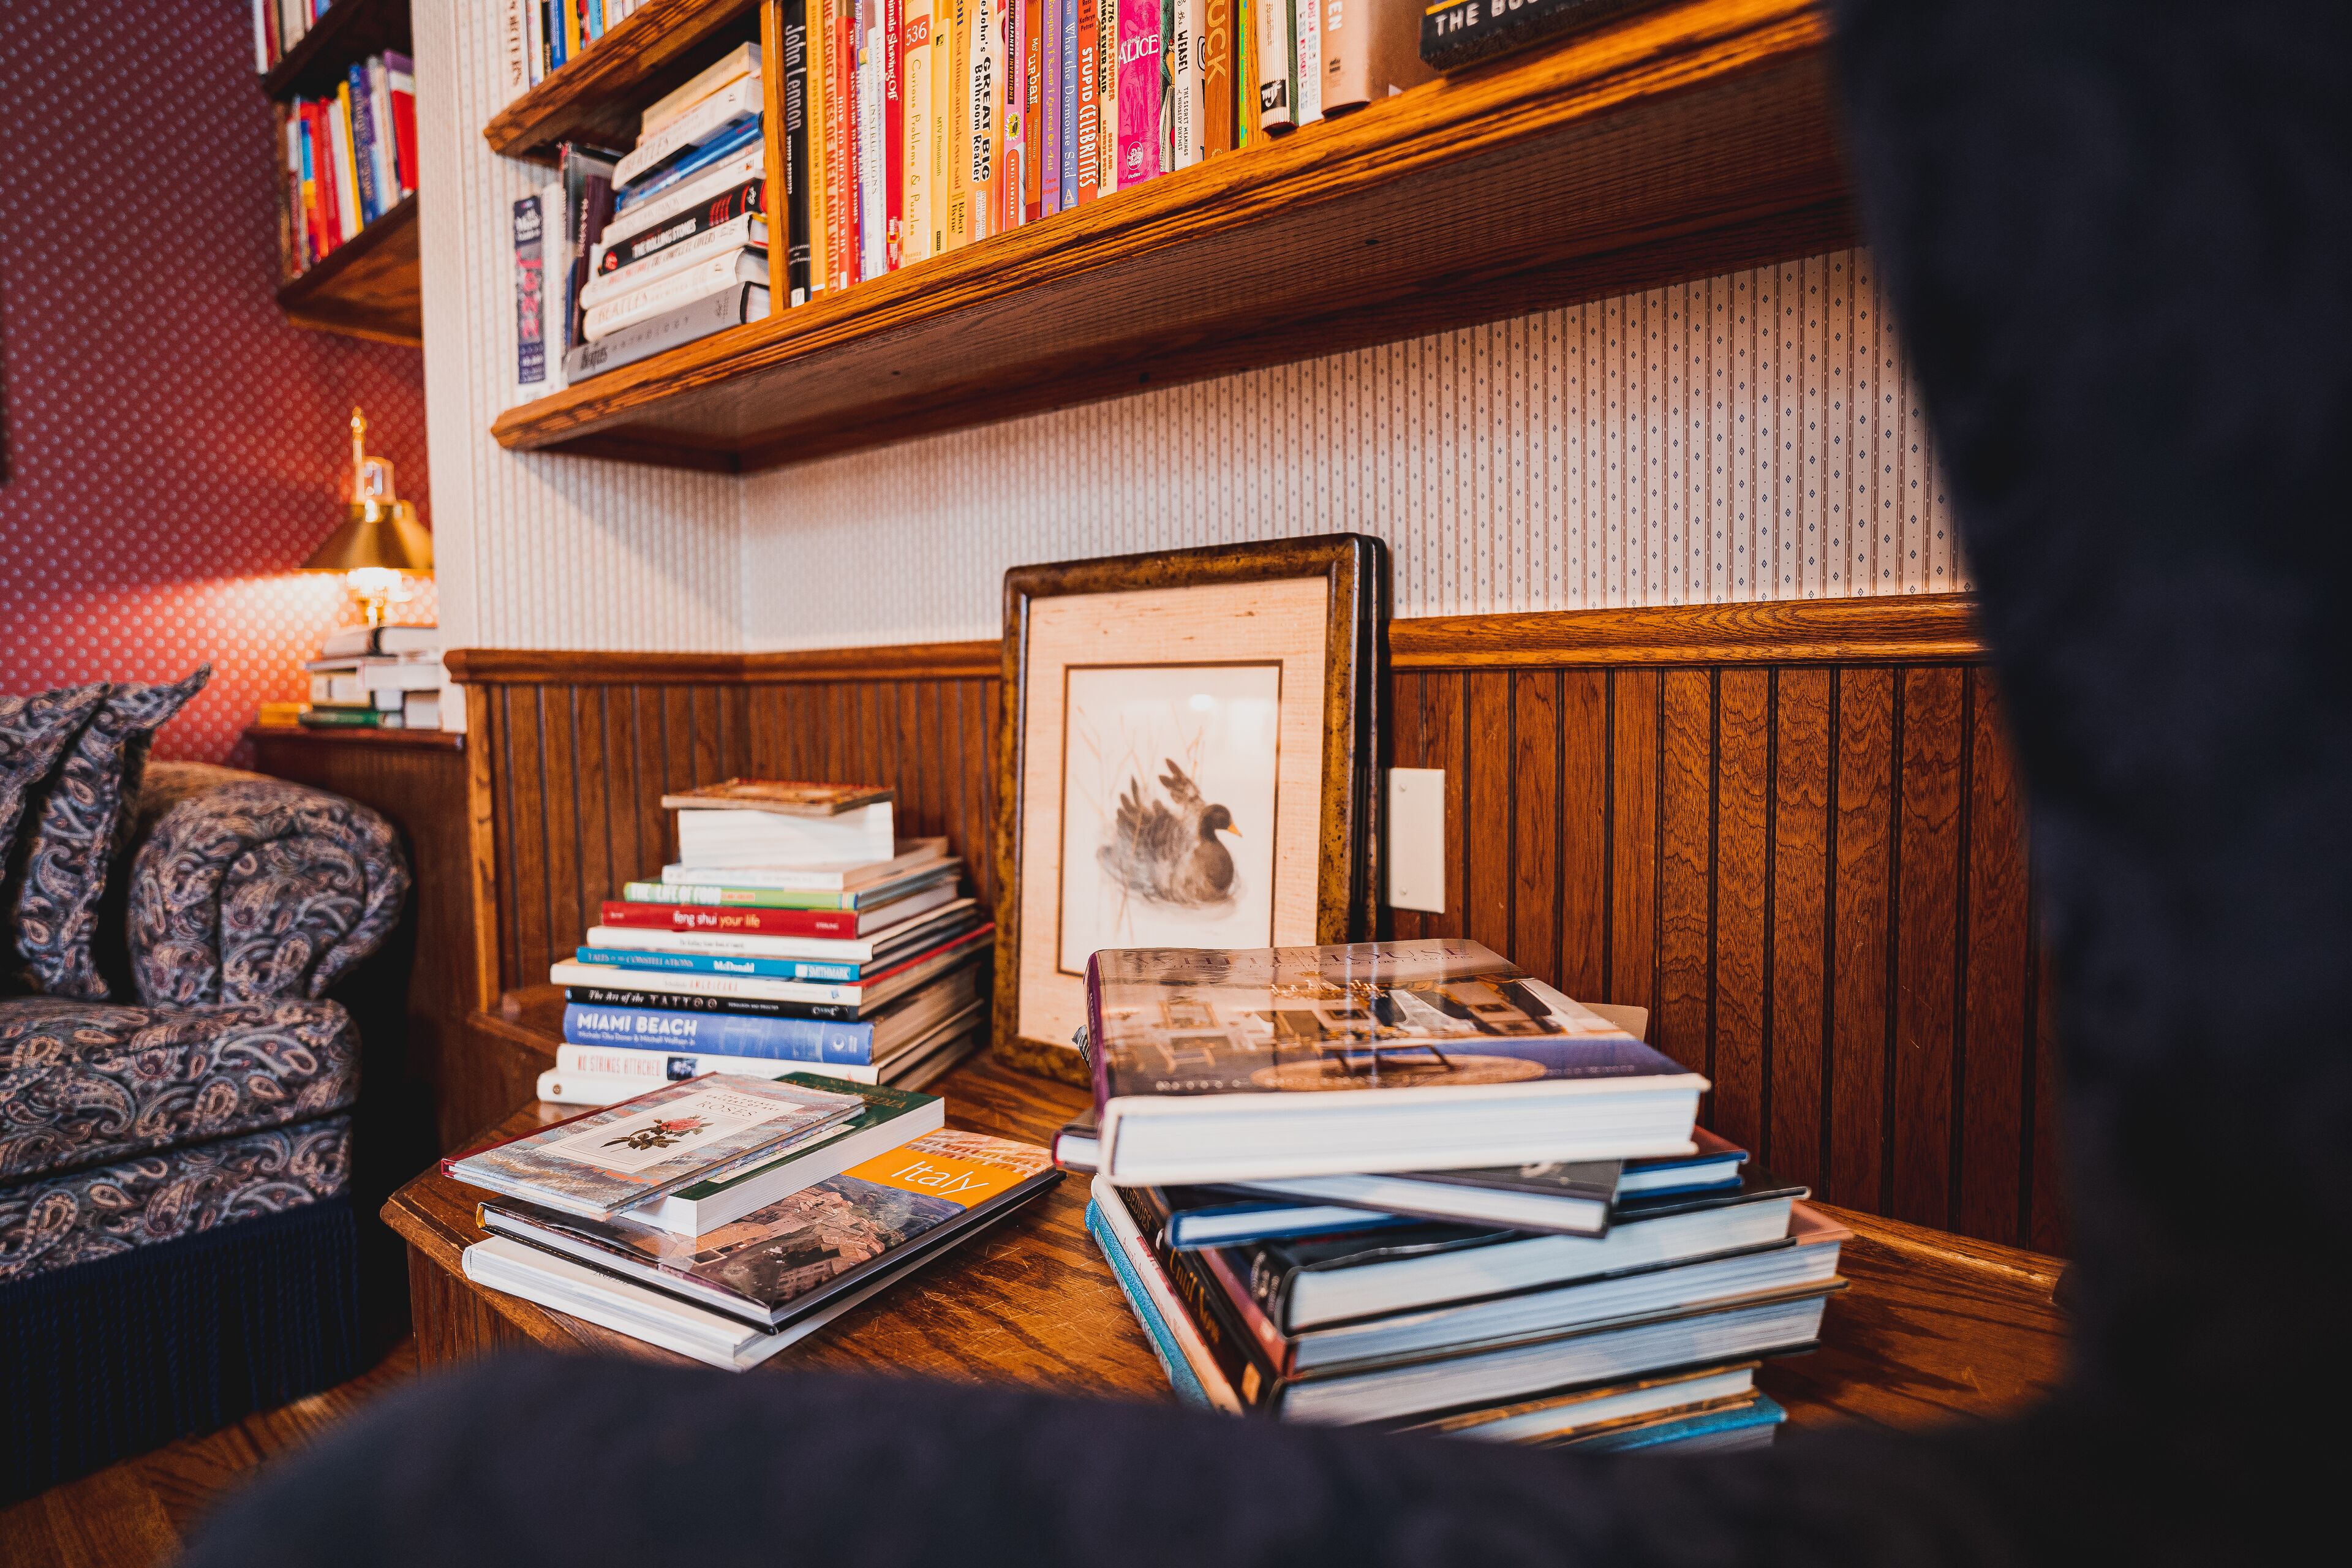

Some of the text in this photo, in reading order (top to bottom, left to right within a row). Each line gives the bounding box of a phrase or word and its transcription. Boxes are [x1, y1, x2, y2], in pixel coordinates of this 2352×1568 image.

[980, 9, 989, 53] John's
[1046, 0, 1056, 48] Everything
[1079, 13, 1096, 24] Kathryn
[1080, 22, 1094, 32] Petras
[1327, 0, 1344, 32] EN
[1434, 2, 1480, 37] THE
[905, 21, 927, 47] 536
[956, 31, 964, 56] Best
[1118, 34, 1159, 69] ALICE
[1177, 11, 1189, 75] the WEASEL
[1207, 0, 1227, 87] UCK
[824, 24, 834, 80] SECRET
[885, 33, 898, 81] Showing
[785, 24, 807, 132] John Lennon
[888, 80, 898, 101] Off
[955, 59, 964, 94] things
[982, 56, 991, 130] GREAT
[825, 83, 835, 123] LIVES
[1064, 21, 1077, 179] What the Dormouse Said
[1079, 47, 1097, 187] STUPID CELEBRITIES
[826, 126, 835, 146] OF
[954, 97, 963, 141] anybody
[973, 64, 984, 182] Bathroom Reader
[838, 129, 844, 145] TO
[870, 103, 878, 195] INSTRUCTIONS
[910, 58, 921, 236] Curious Problems & Puzzles
[826, 148, 837, 188] MEN
[981, 138, 990, 181] BIG
[954, 167, 963, 190] said
[827, 194, 837, 227] AND
[674, 910, 761, 930] feng shui your life
[713, 959, 756, 974] McDonald
[807, 964, 851, 981] SMITHMARK
[1307, 947, 1471, 964] HOUSE
[588, 989, 718, 1011] The Art of the TATTOO
[576, 1012, 699, 1037] MIAMI BEACH
[577, 1054, 661, 1077] NO STRINGS ATTACHED
[695, 1101, 758, 1117] ROSES
[890, 1161, 990, 1196] Italy
[1125, 1186, 1152, 1232] GEDDES
[1169, 1246, 1199, 1303] Until
